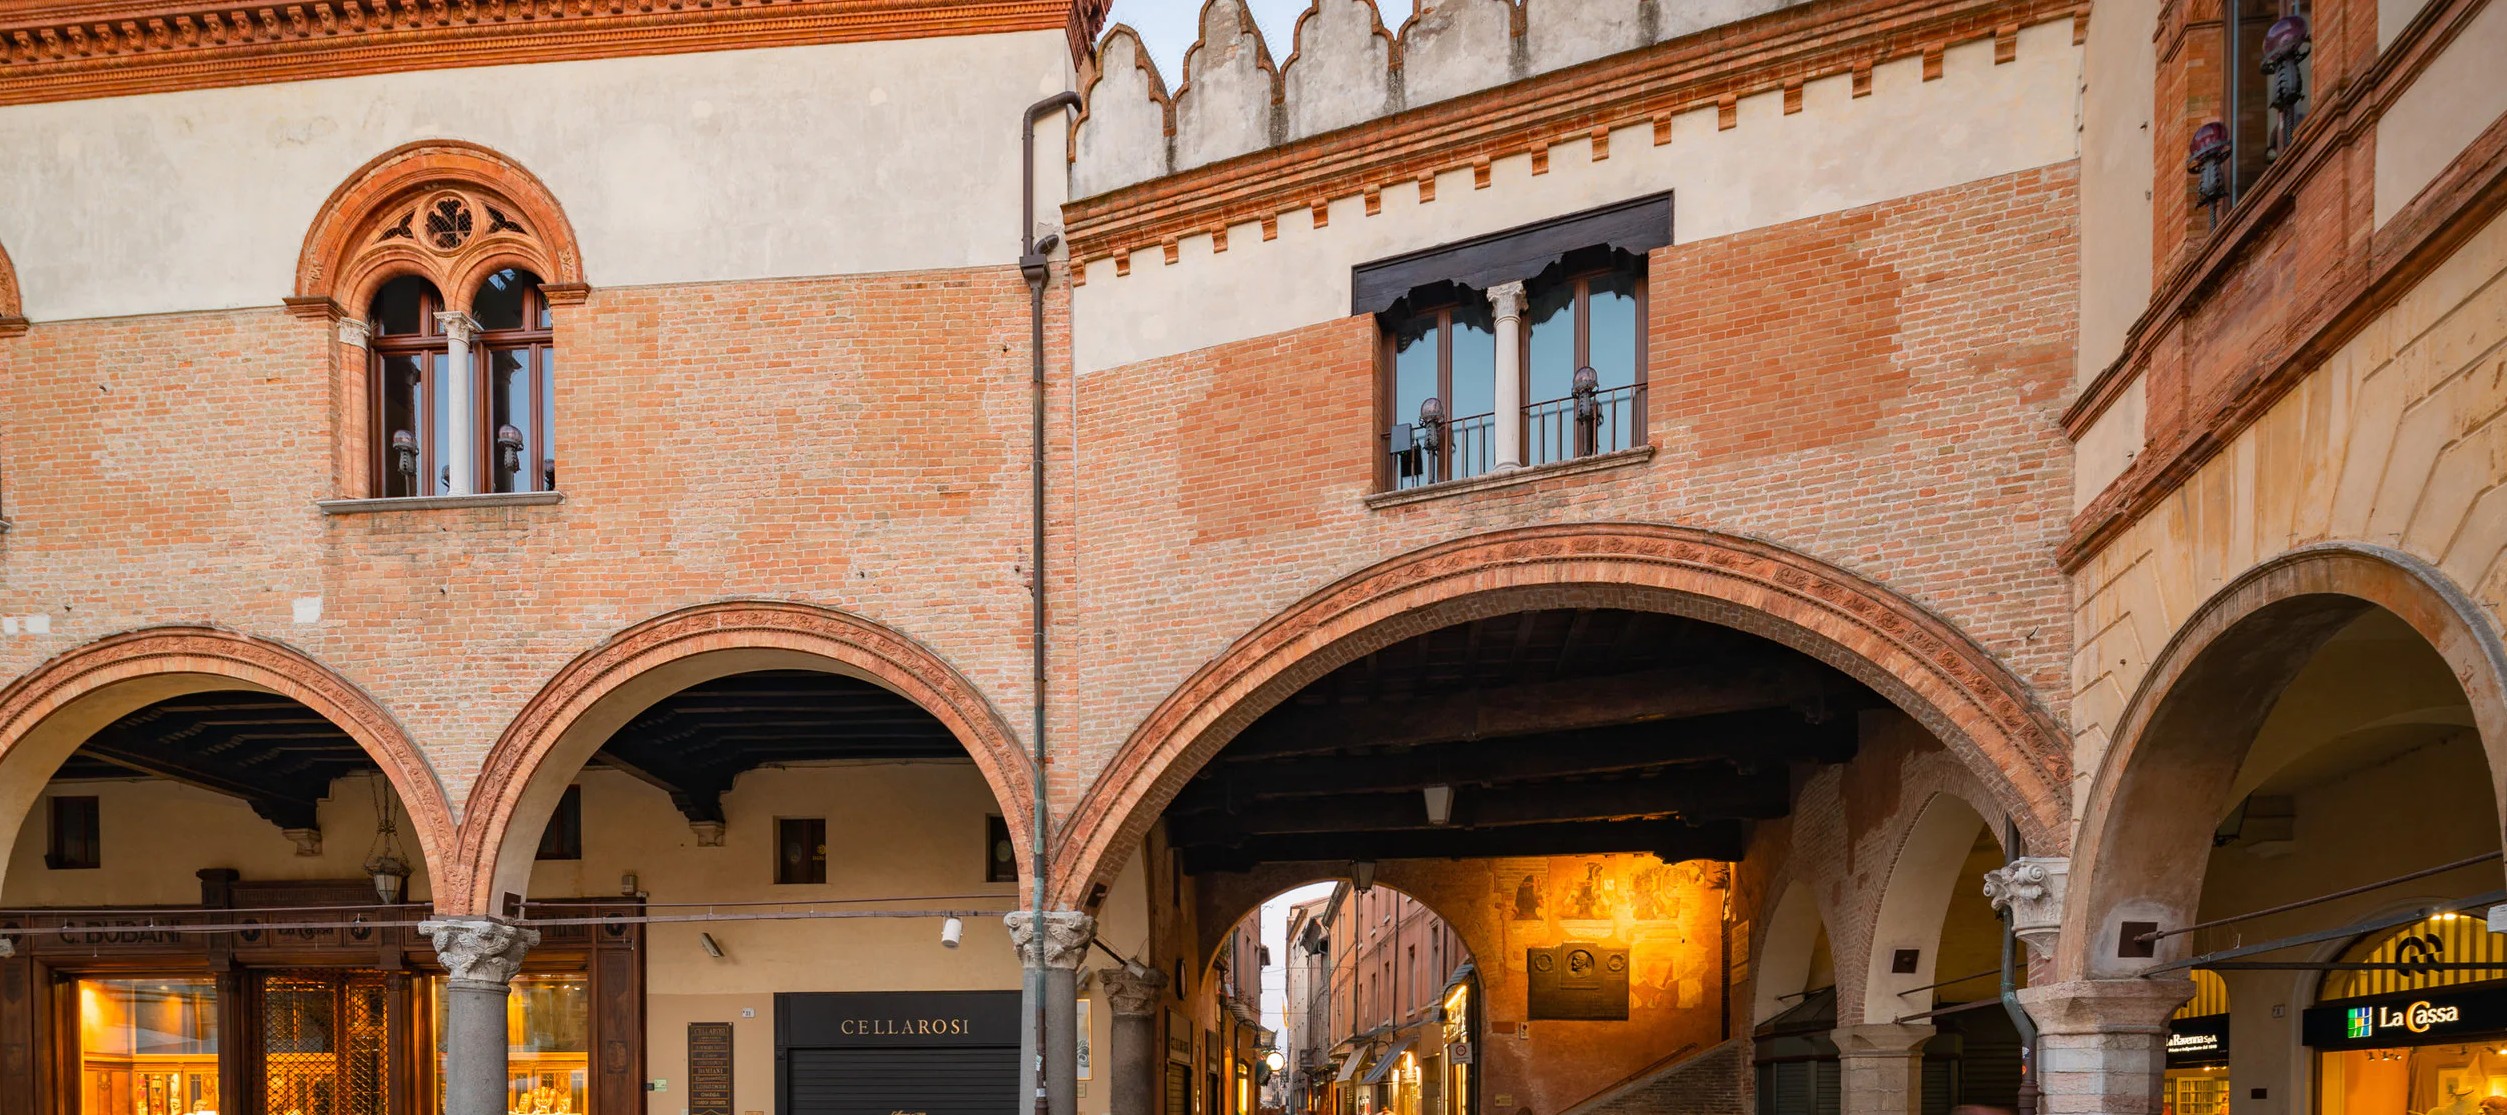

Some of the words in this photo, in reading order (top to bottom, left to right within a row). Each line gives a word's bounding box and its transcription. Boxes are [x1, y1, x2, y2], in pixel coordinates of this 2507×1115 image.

[2379, 1006, 2404, 1028] La
[2405, 1000, 2459, 1033] Cassa
[840, 1018, 969, 1036] CELLAROSI
[2173, 1034, 2204, 1046] Ravenna
